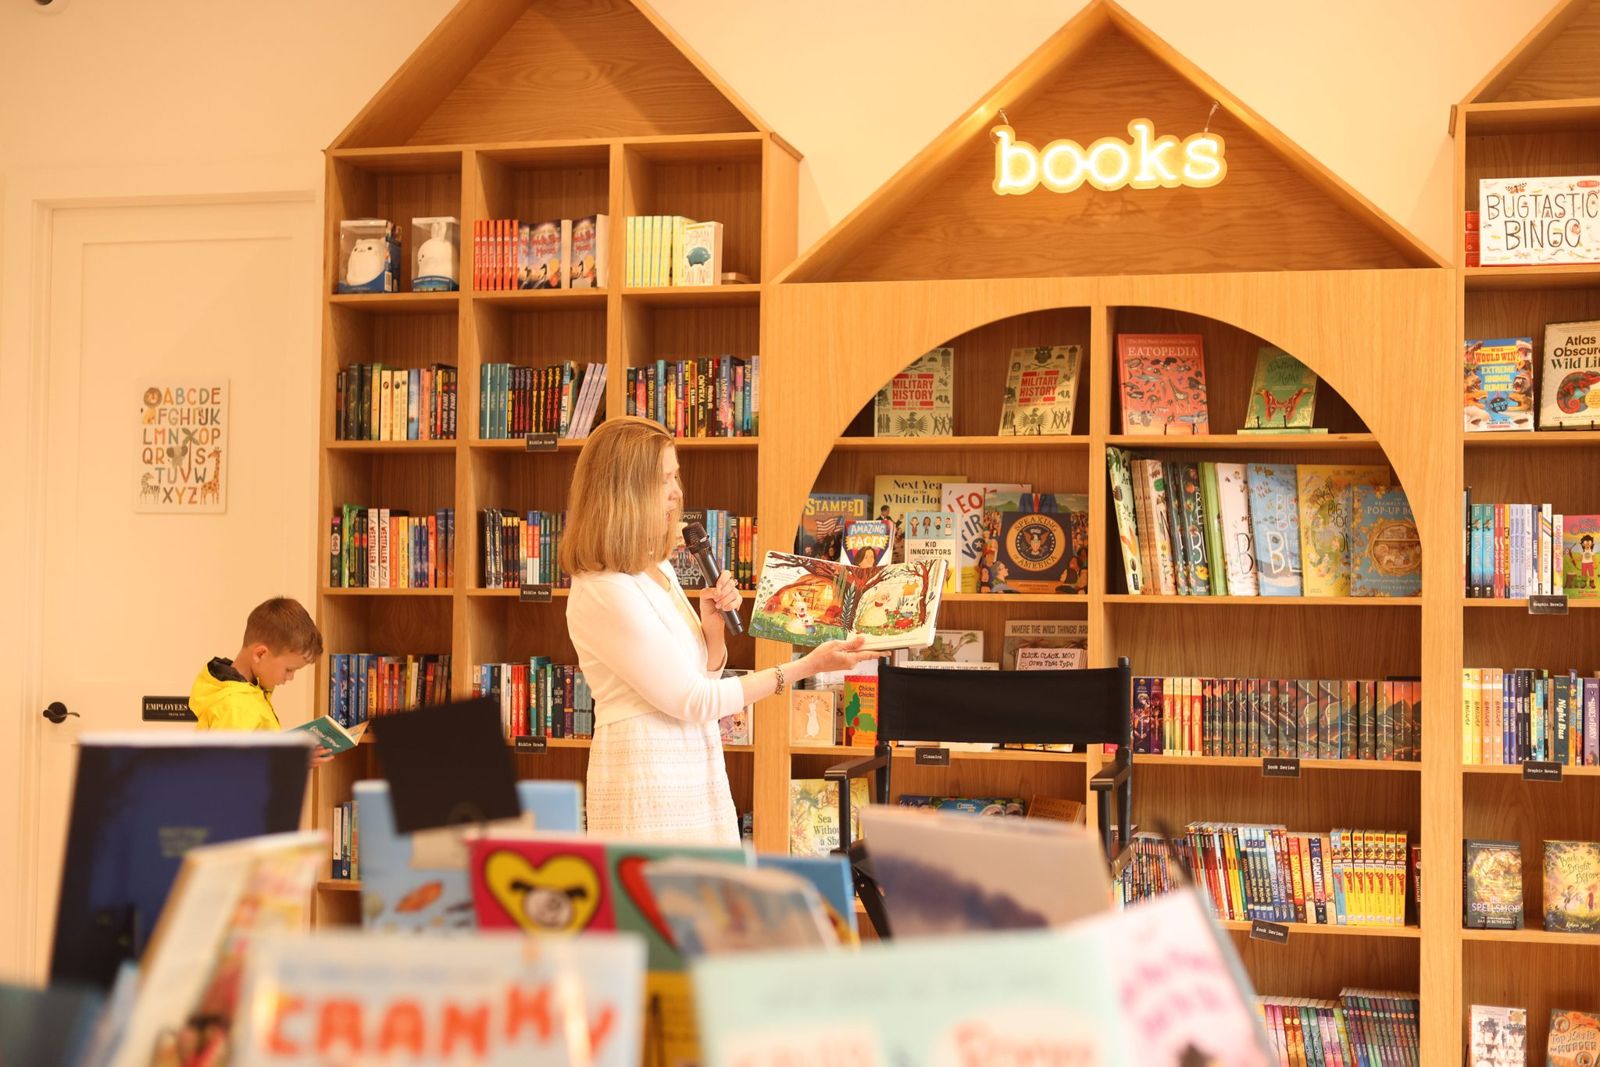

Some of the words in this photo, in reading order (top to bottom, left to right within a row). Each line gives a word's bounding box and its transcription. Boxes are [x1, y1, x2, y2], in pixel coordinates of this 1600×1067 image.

[993, 120, 1225, 193] books
[1486, 193, 1599, 220] BUGTASTIC
[1504, 219, 1581, 250] BINGO
[1565, 336, 1596, 346] Atlas
[1128, 346, 1198, 356] EATOPEDIA
[1551, 357, 1580, 370] Wild
[1585, 356, 1600, 368] Li
[892, 380, 934, 390] MILITARY
[1021, 376, 1058, 386] MILITARY
[163, 387, 222, 405] ABCDE
[892, 390, 934, 400] HISTORY
[1019, 386, 1057, 398] HISTORY
[894, 480, 919, 490] Next
[922, 480, 942, 490] Yea
[162, 487, 198, 504] XYZ
[884, 494, 918, 504] White
[805, 498, 864, 517] STAMPED
[850, 524, 886, 534] AMAZING
[850, 536, 885, 548] FACTS
[1018, 554, 1057, 568] AMERICA
[1012, 625, 1030, 634] WHERE
[1032, 625, 1040, 634] THE
[1042, 625, 1055, 634] WILD
[1057, 625, 1077, 634] THINGS
[1557, 698, 1566, 722] Night
[1557, 723, 1566, 739] Bus
[818, 814, 832, 823] Sea
[814, 826, 839, 834] Witho
[1472, 903, 1520, 912] SPELLSHOP
